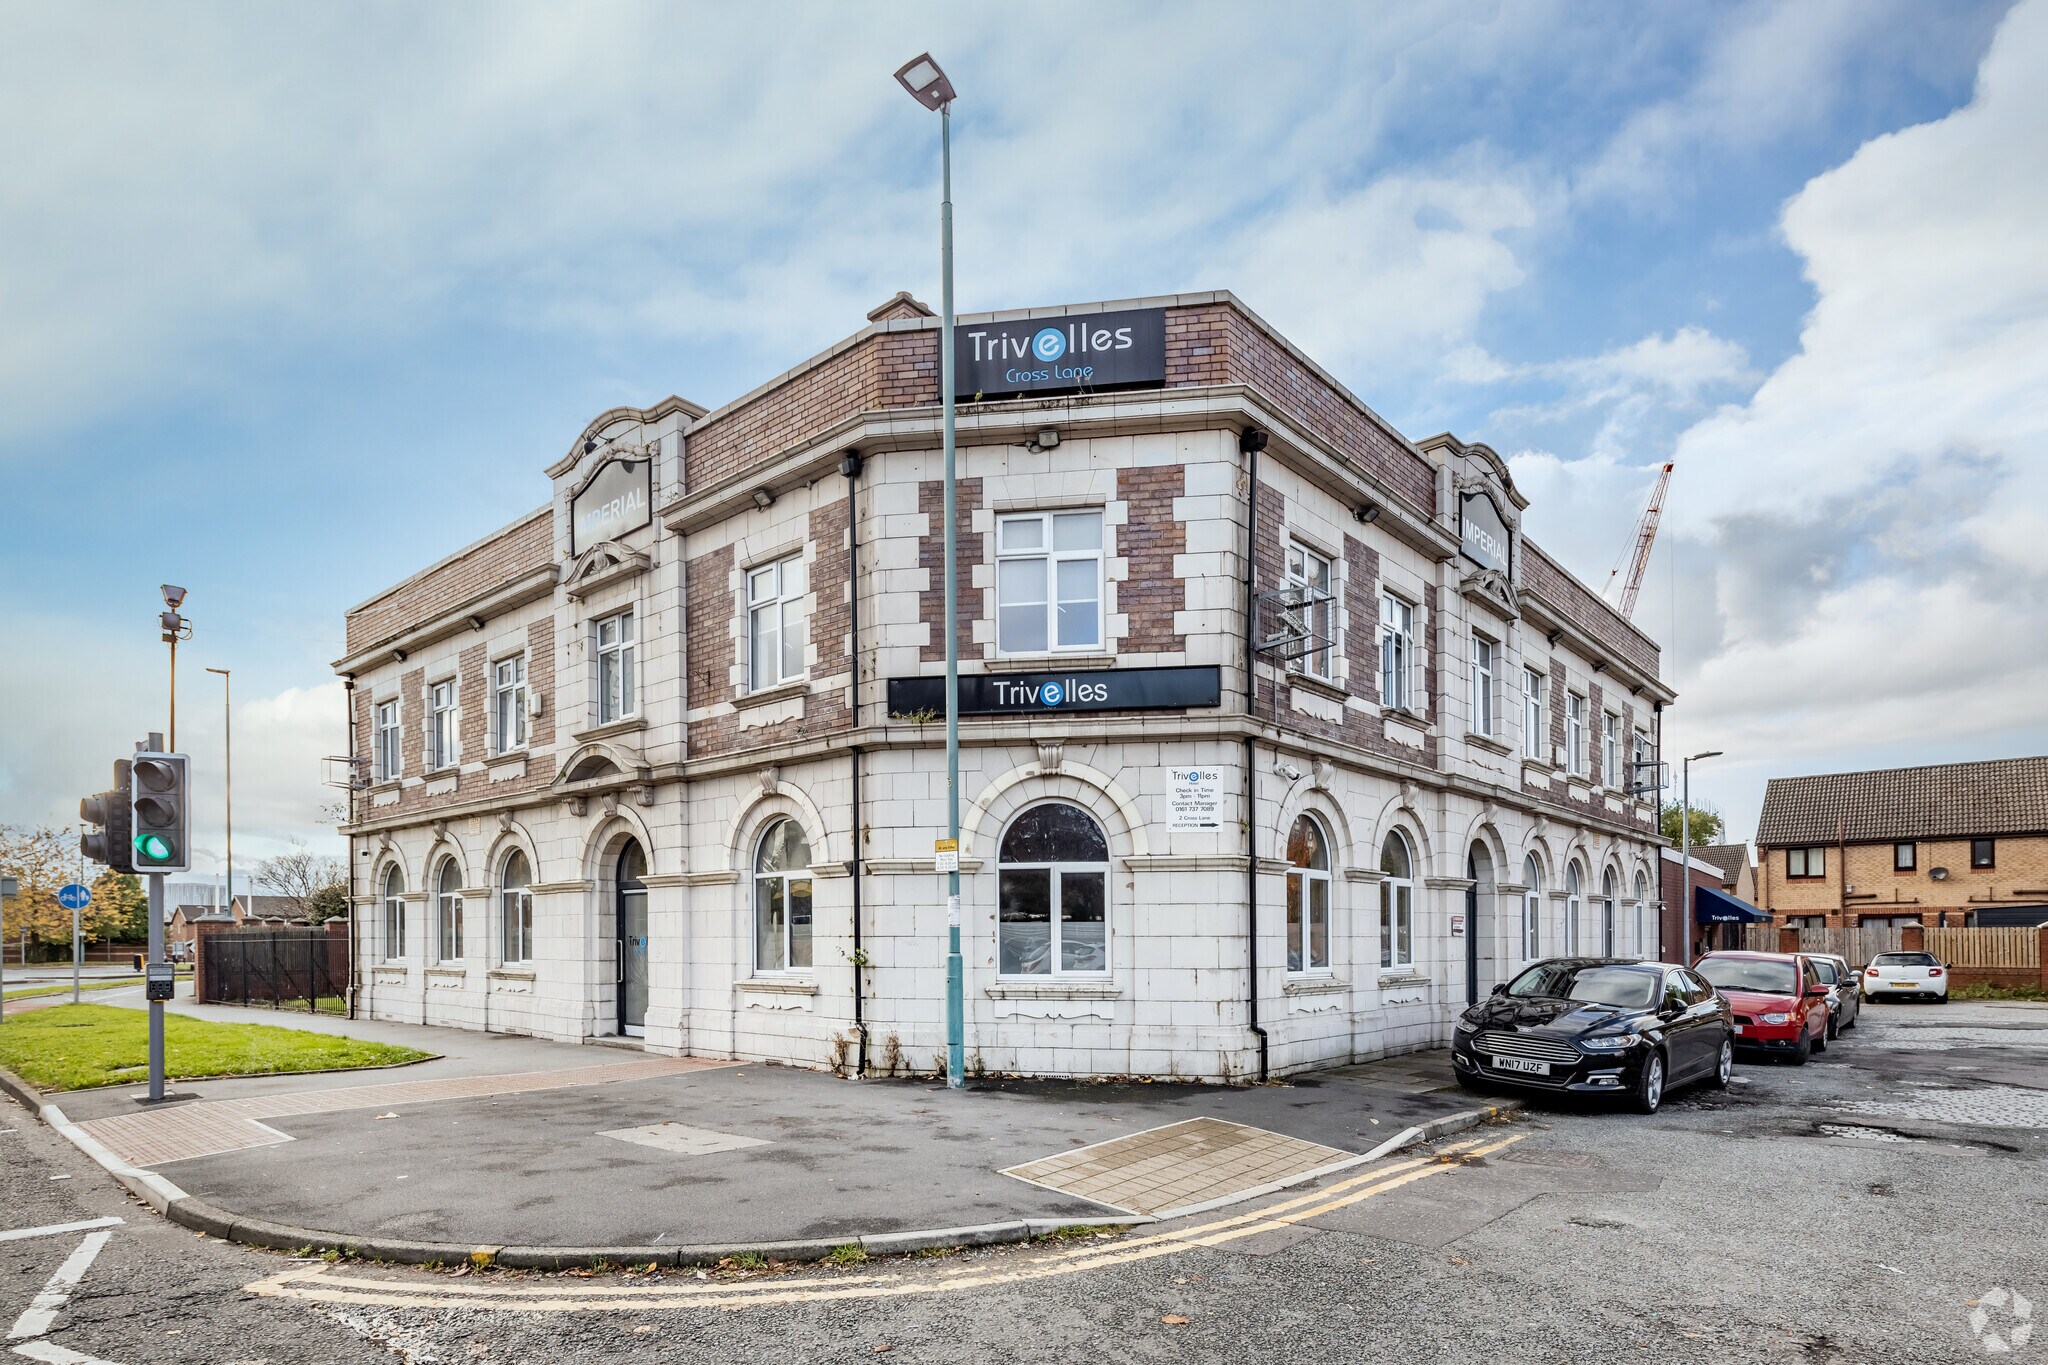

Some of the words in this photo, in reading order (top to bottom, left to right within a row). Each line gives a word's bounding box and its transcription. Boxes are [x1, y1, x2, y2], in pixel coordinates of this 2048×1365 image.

[968, 322, 1133, 362] Trivelles
[1005, 368, 1049, 383] Cross
[1055, 365, 1094, 380] Lane
[1462, 516, 1507, 566] IMPERIAL
[993, 679, 1108, 706] Trivelles
[1172, 771, 1218, 781] Trivelles
[1499, 1058, 1520, 1069] WN17
[1523, 1062, 1543, 1072] UZF
